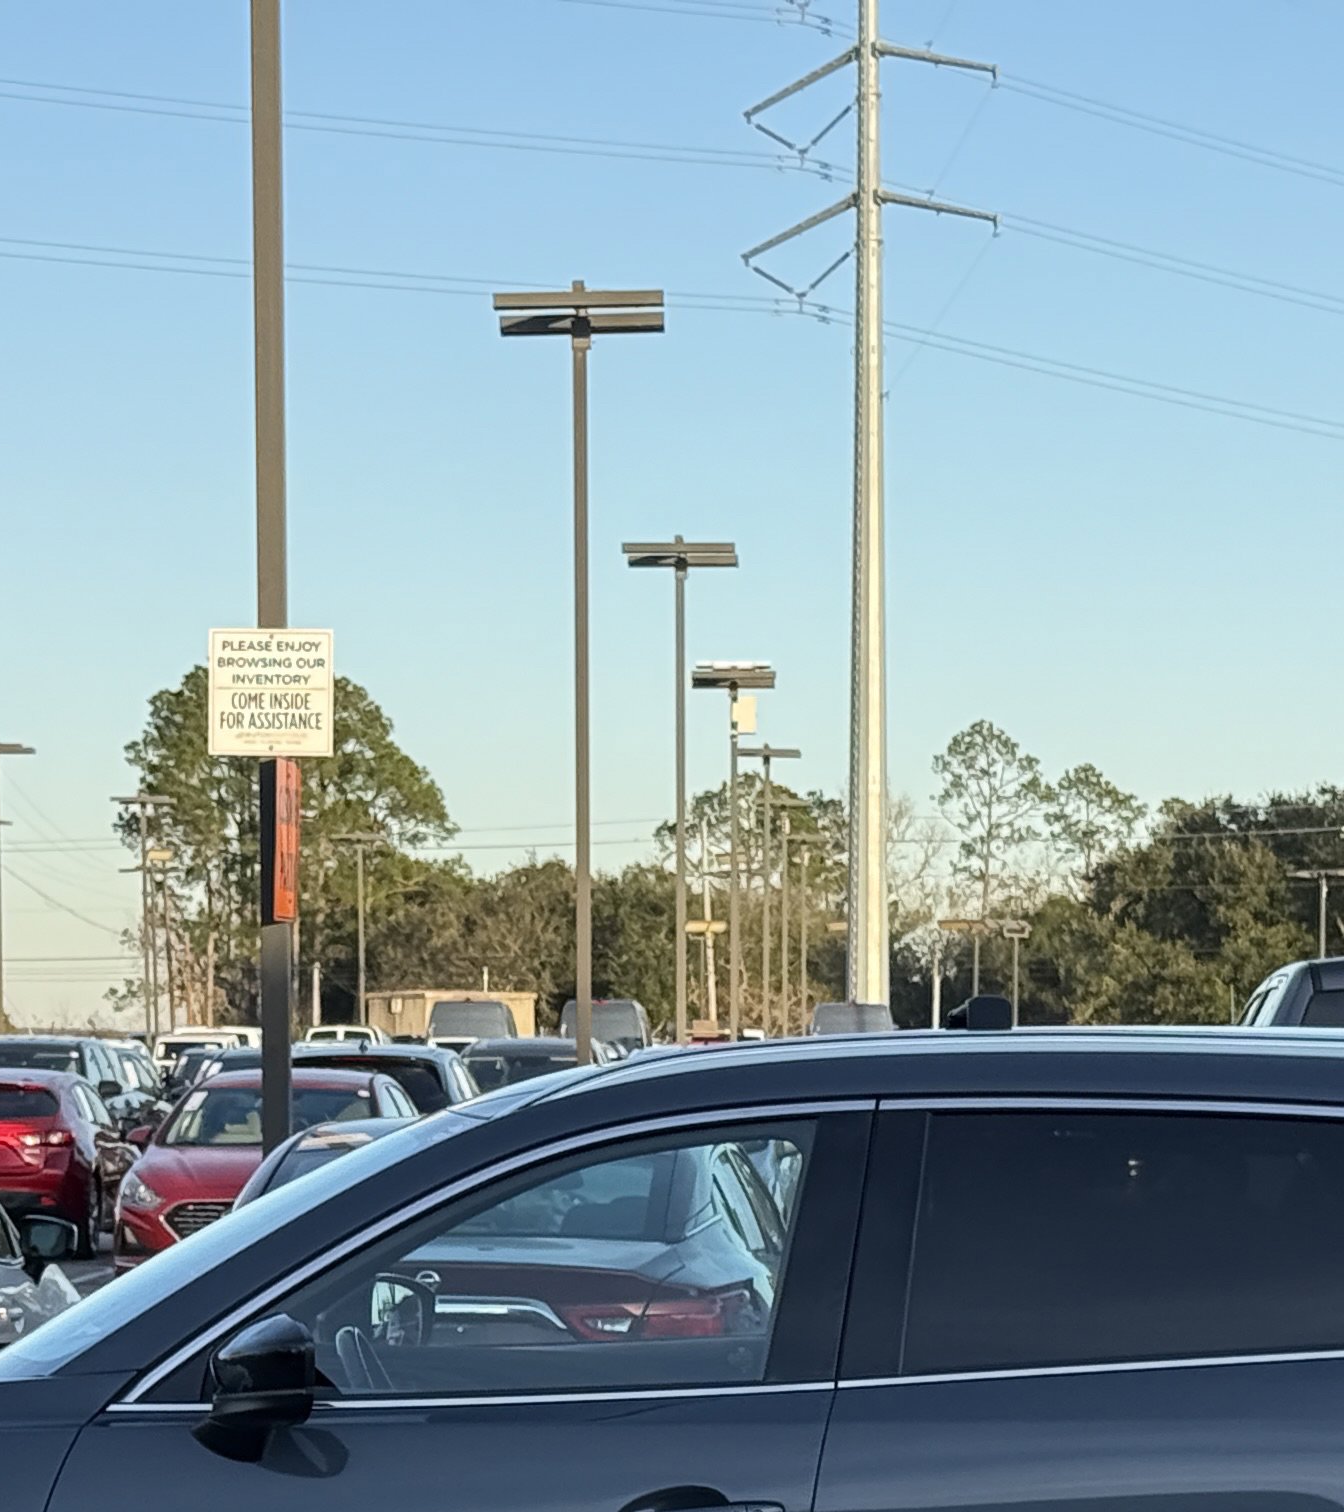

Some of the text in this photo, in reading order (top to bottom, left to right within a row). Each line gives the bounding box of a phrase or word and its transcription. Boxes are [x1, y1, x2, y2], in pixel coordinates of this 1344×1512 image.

[222, 640, 322, 653] PLEASE ENJOY
[217, 657, 326, 669] BROWSING OUR
[232, 674, 311, 686] INVENTORY
[231, 692, 312, 711] COME INSIDE
[219, 711, 323, 730] FOR ASSISTANCE
